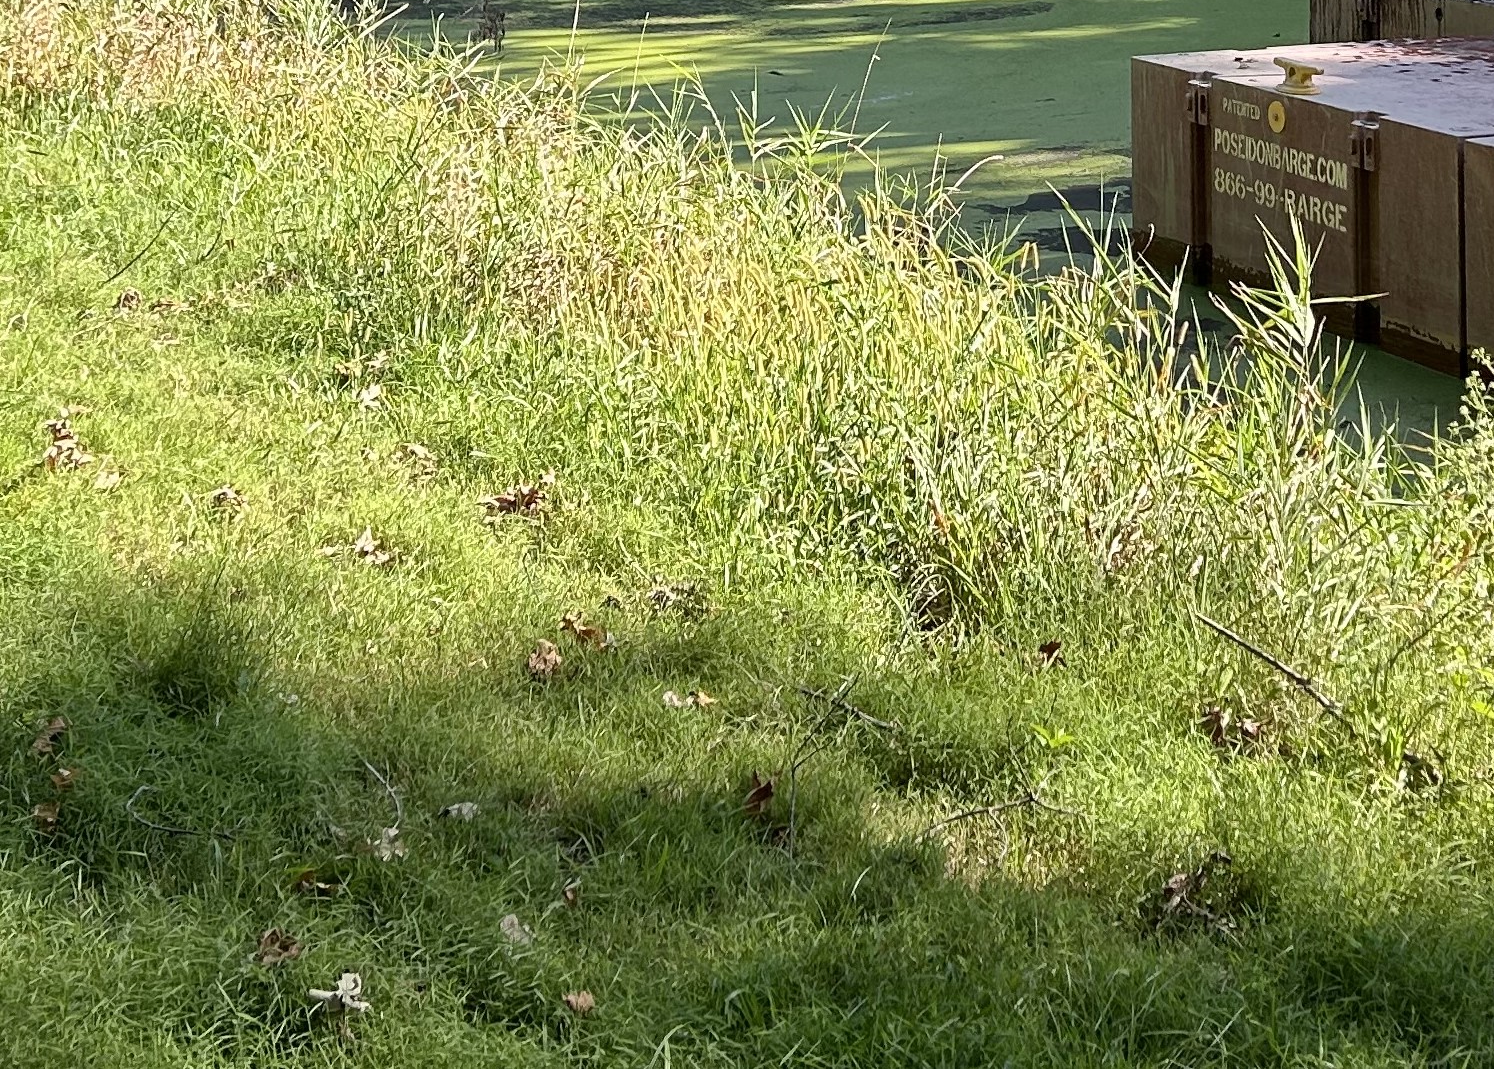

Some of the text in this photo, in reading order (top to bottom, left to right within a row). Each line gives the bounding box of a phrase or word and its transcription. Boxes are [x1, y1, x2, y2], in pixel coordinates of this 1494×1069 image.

[1222, 97, 1261, 120] PATENTED
[1214, 127, 1348, 191] POSEIDONBARGE.COM
[1214, 167, 1348, 232] 866-99-BARGE
